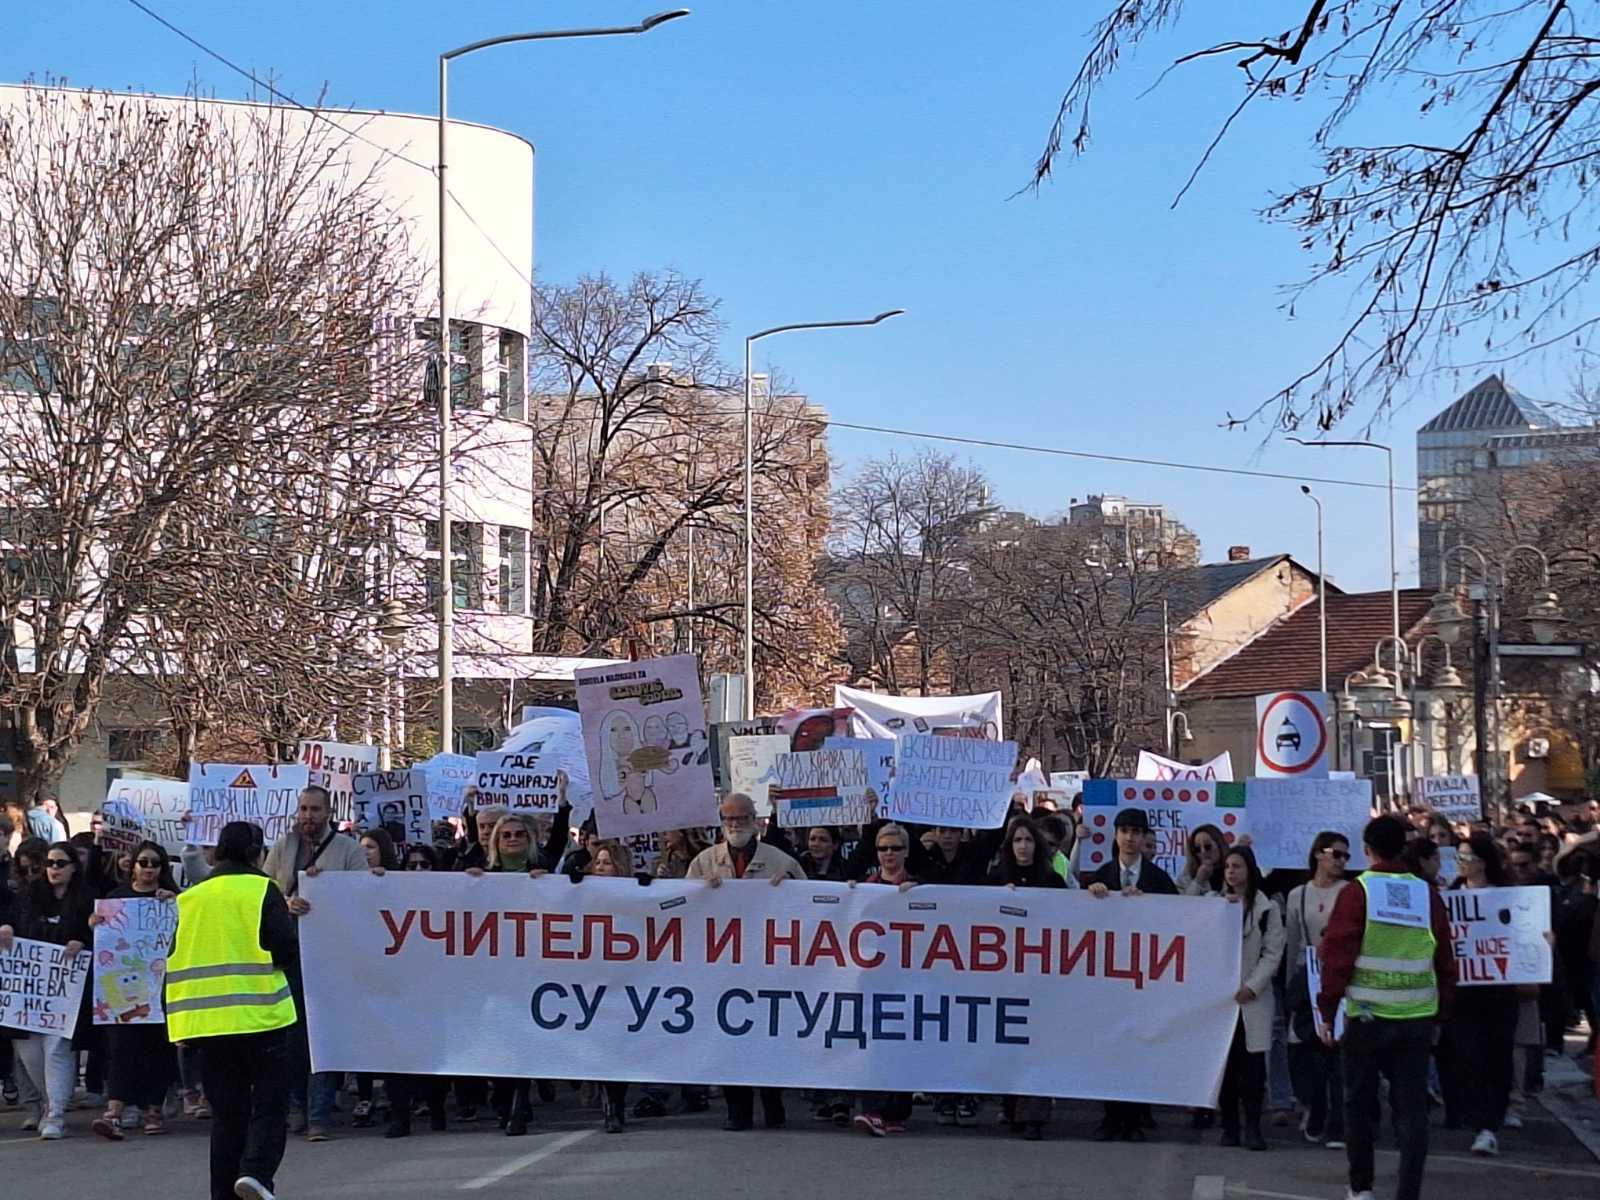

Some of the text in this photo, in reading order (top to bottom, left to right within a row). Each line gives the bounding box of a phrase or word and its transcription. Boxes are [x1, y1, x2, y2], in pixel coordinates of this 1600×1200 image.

[500, 755, 541, 769] ГДЕ
[351, 771, 412, 795] СТАВИ
[478, 772, 559, 789] СТУДИРАЈУ
[513, 794, 559, 810] ДЕЦА?
[30, 945, 44, 962] СЕ
[380, 910, 1186, 990] УЧИТЕЉИ И НАСТАВНИЦИ
[49, 965, 79, 984] ПРЕ
[531, 982, 1031, 1051] СУ УЗ СТУДЕНТЕ
